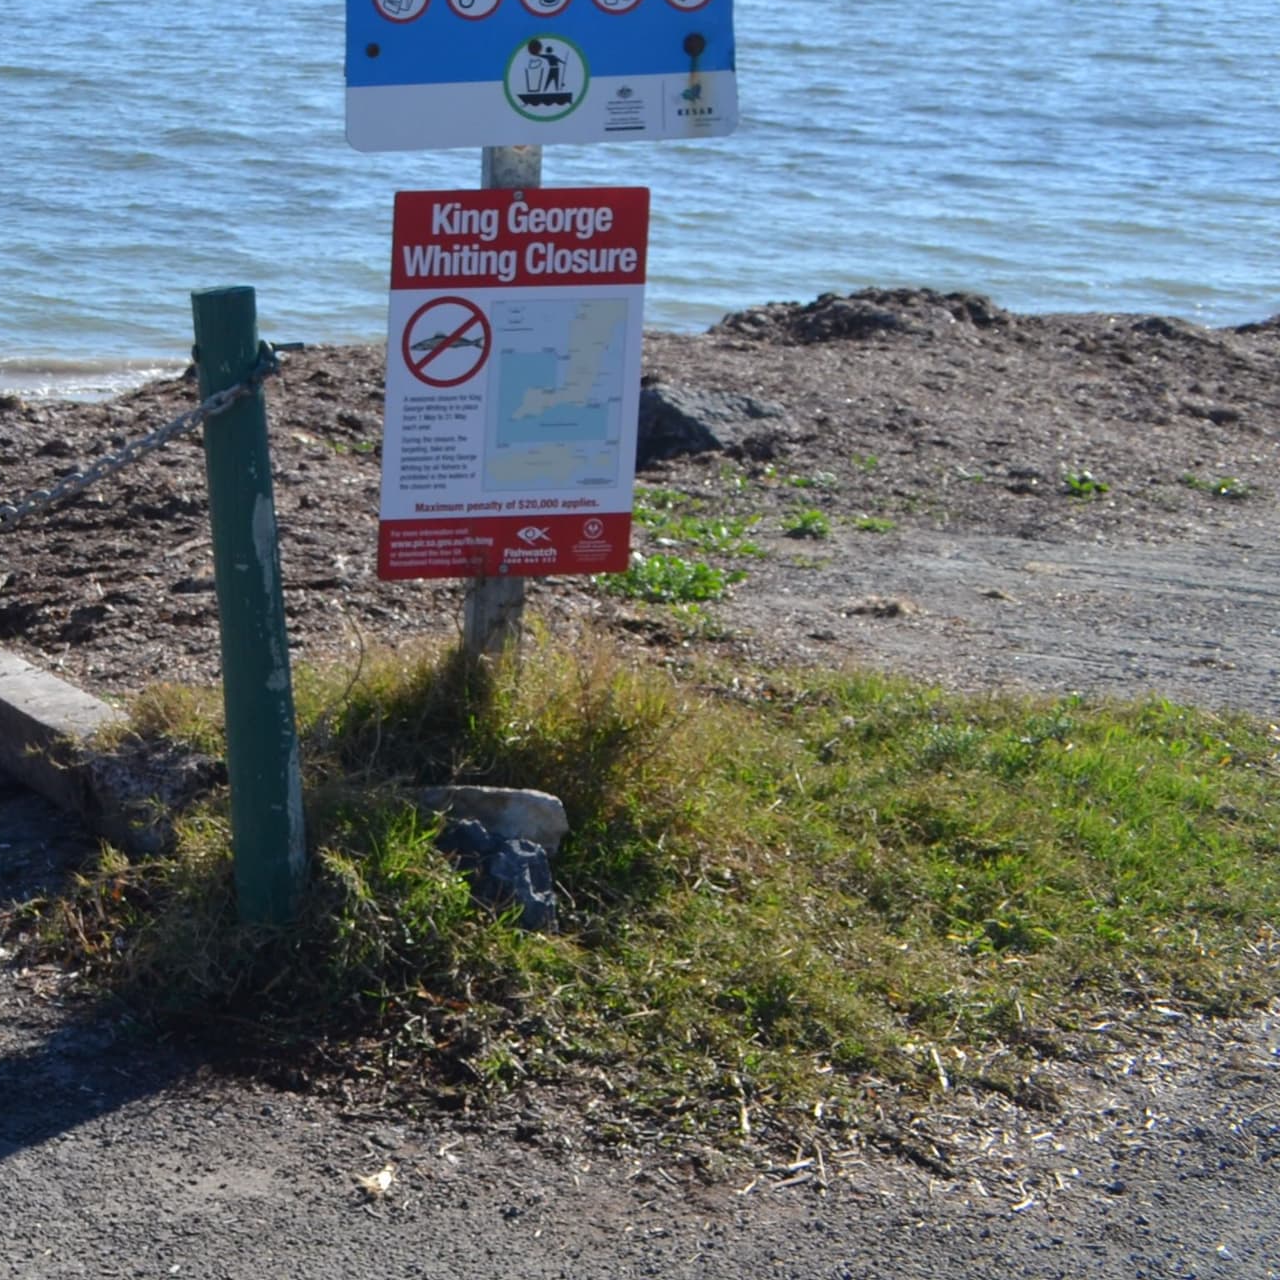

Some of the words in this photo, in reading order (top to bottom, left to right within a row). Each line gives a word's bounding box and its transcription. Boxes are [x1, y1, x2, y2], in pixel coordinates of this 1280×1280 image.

[431, 202, 499, 241] King
[508, 200, 613, 240] George
[403, 243, 517, 283] Whiting
[525, 241, 638, 274] Closure
[415, 501, 464, 512] Maximum
[466, 500, 502, 513] penalty
[505, 500, 516, 510] of
[518, 498, 558, 511] $20,000
[561, 497, 599, 510] applies.
[504, 547, 557, 558] Fishwatch
